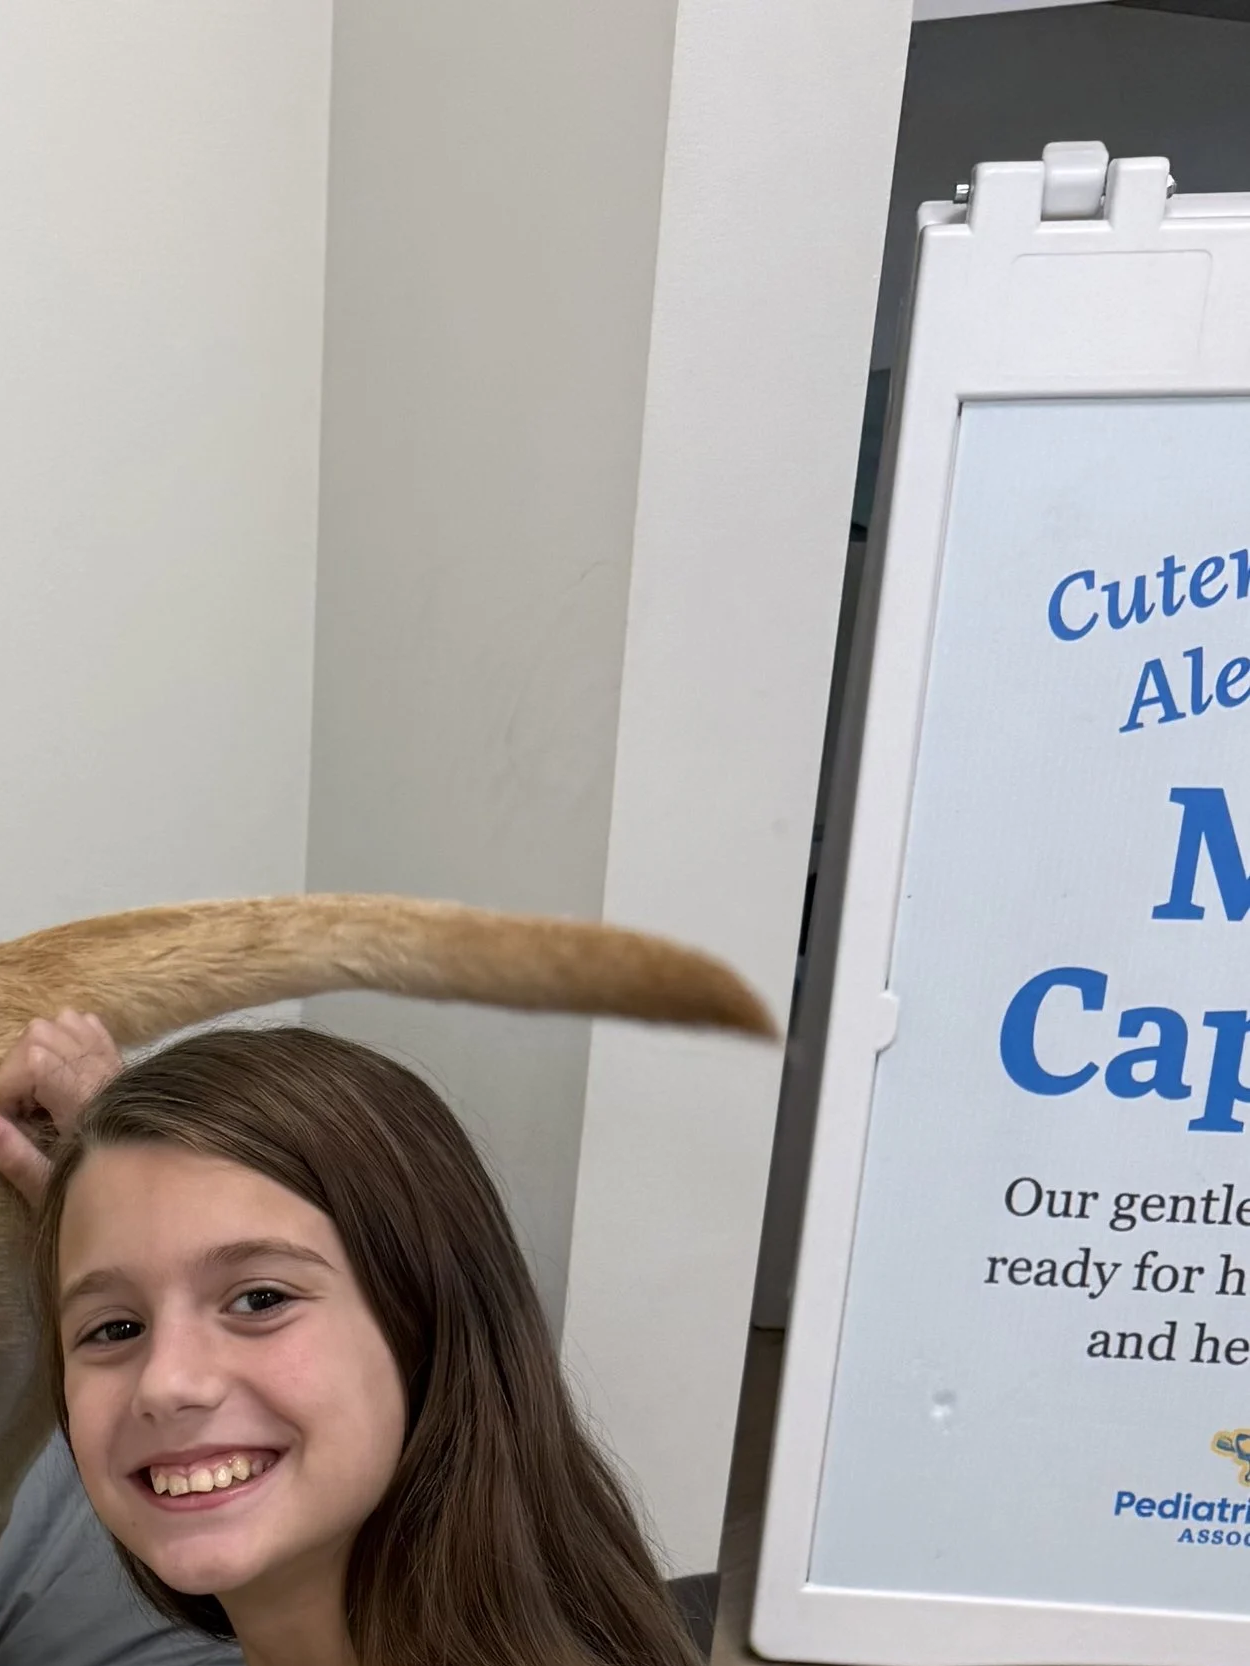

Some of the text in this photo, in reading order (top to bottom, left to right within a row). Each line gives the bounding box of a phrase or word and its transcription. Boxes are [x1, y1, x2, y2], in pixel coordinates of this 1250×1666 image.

[1118, 646, 1250, 733] Ale
[1004, 1177, 1099, 1219] Our
[983, 1247, 1122, 1300] ready
[1132, 1250, 1205, 1294] for
[1086, 1320, 1250, 1366] and he
